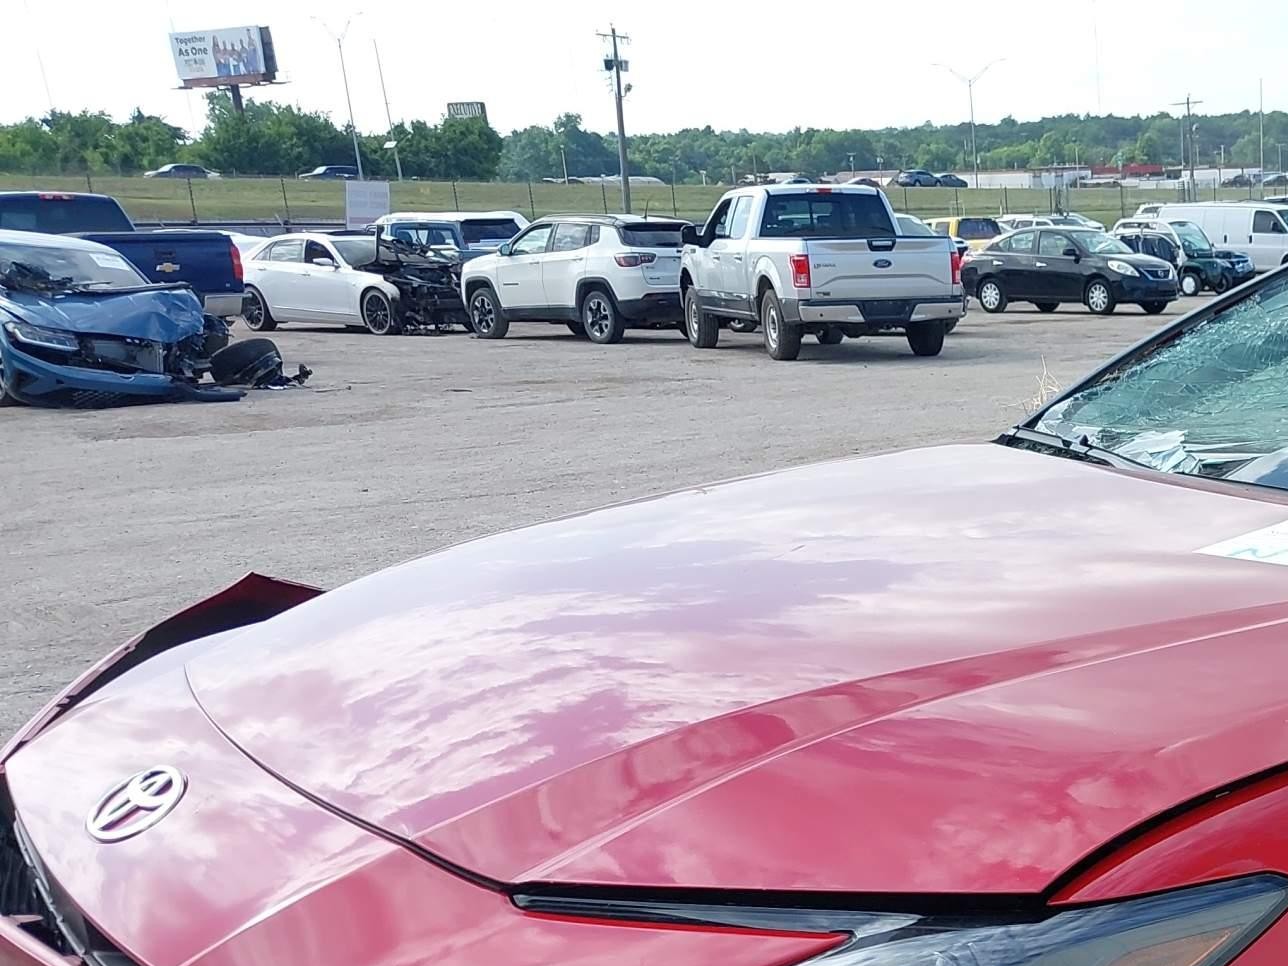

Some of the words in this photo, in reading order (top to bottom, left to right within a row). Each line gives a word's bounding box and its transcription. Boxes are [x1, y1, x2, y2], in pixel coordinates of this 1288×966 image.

[174, 36, 205, 46] Together
[178, 47, 190, 57] As
[190, 46, 209, 56] One
